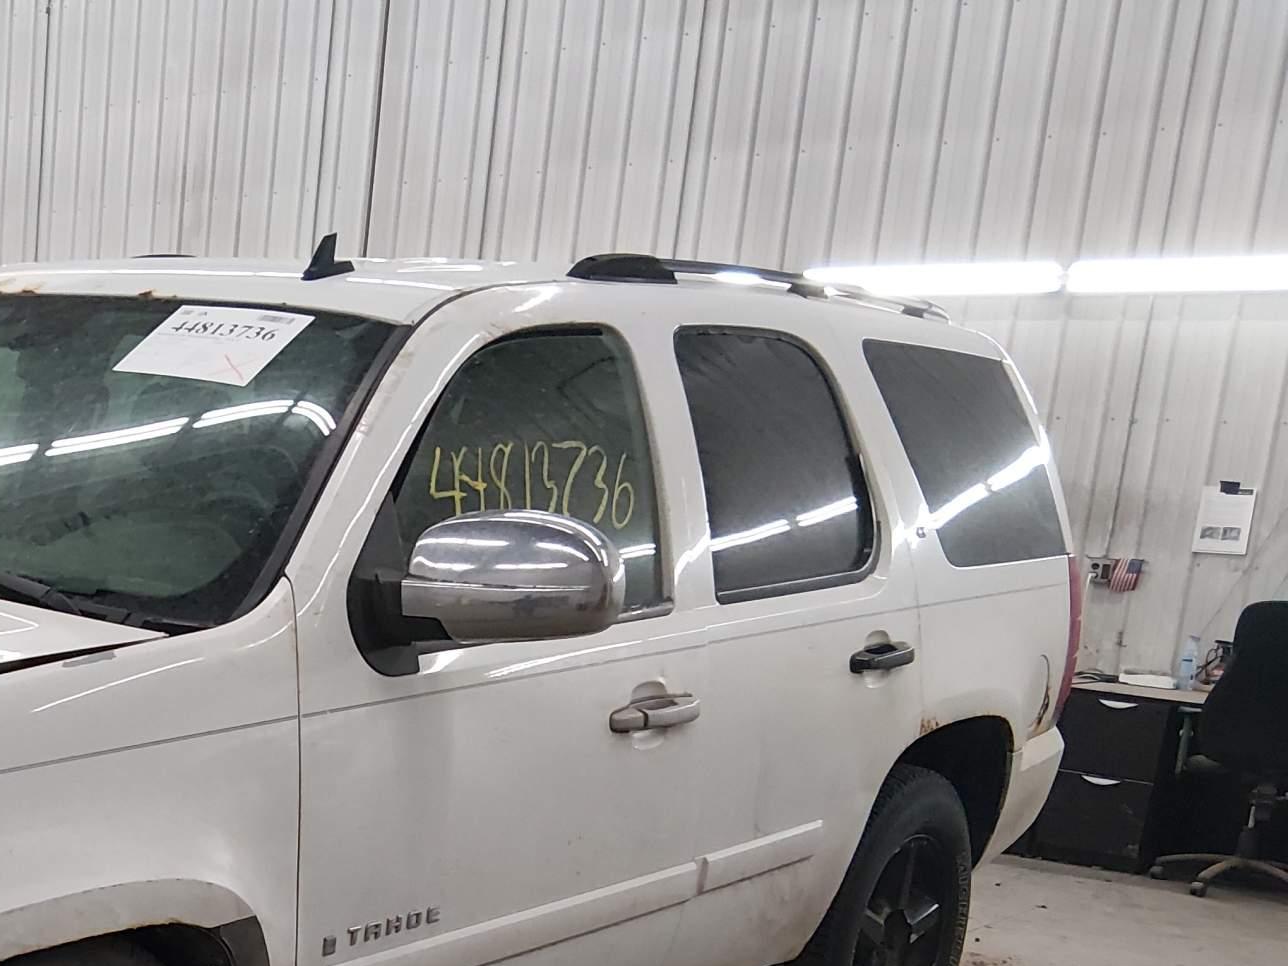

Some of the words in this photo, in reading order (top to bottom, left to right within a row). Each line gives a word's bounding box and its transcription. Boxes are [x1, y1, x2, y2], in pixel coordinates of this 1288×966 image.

[170, 320, 279, 342] 44813736
[429, 440, 636, 529] 44813736
[346, 906, 442, 947] TAHOE
